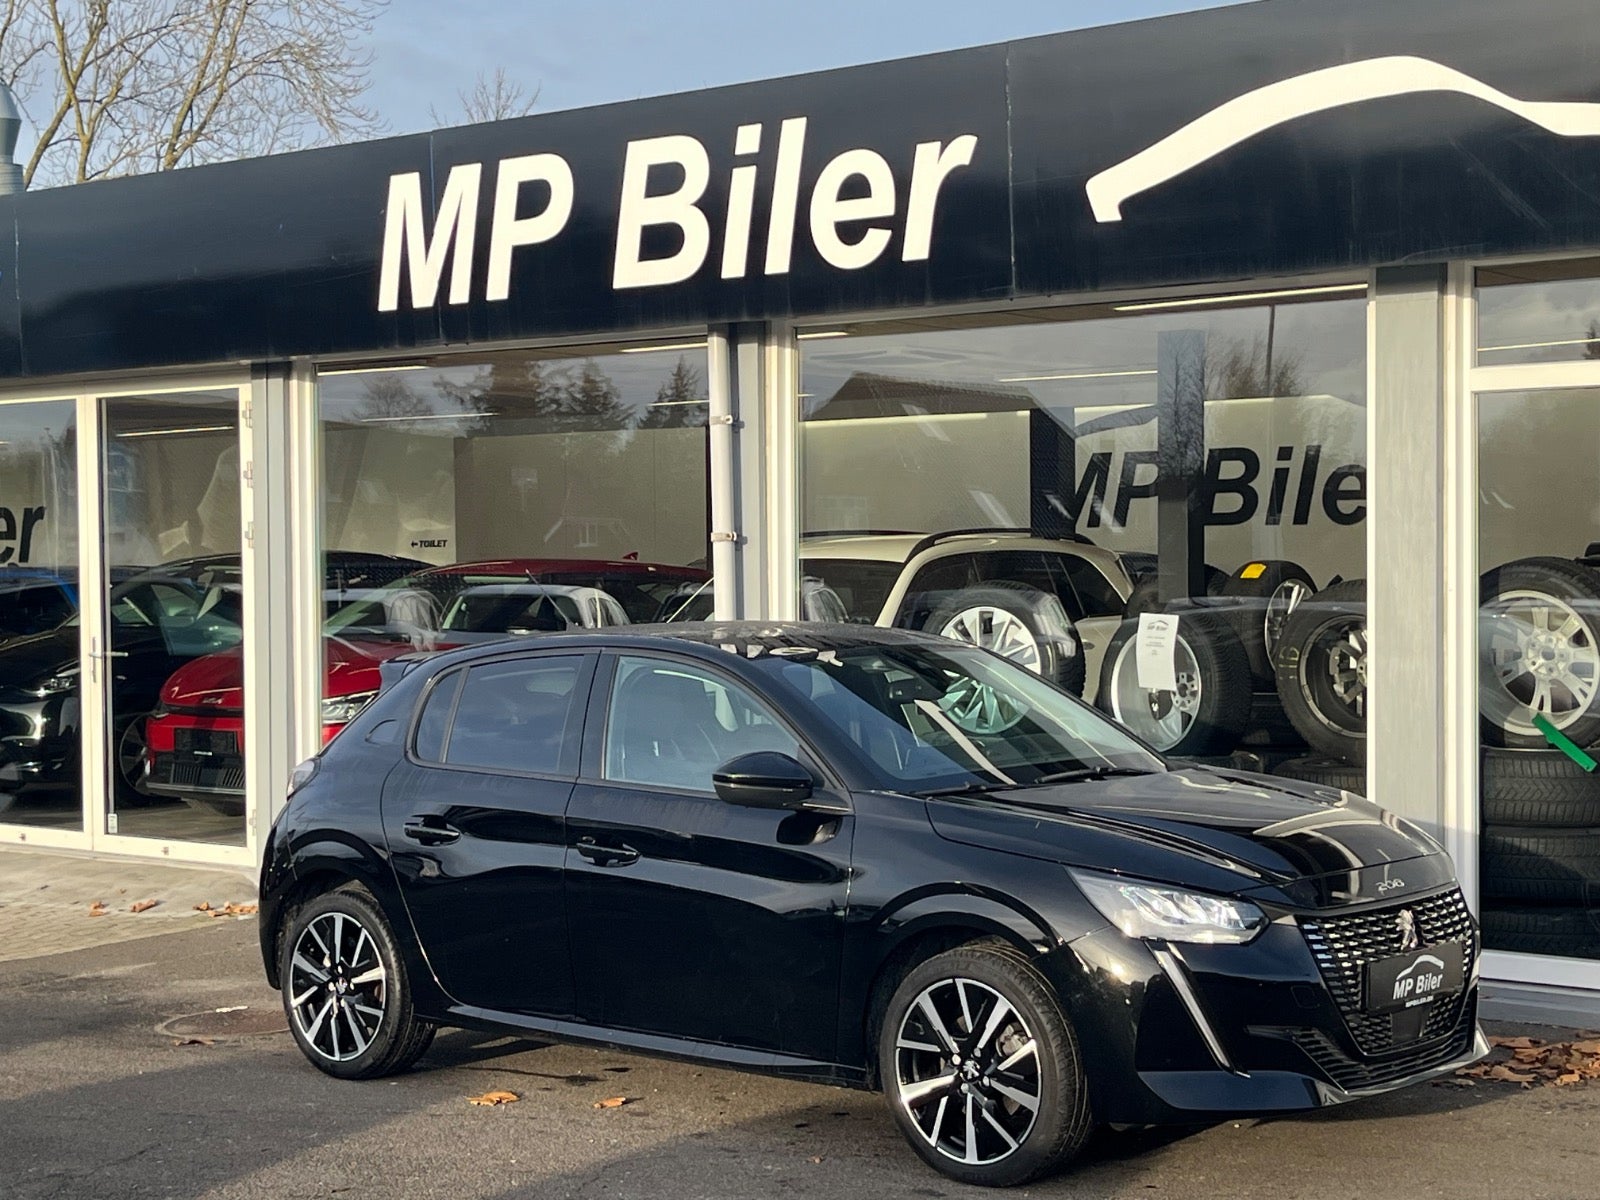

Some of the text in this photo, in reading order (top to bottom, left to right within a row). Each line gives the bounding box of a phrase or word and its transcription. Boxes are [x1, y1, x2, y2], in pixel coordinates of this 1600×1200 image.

[378, 116, 978, 312] MP Biler
[419, 540, 448, 548] TOILET
[1375, 878, 1405, 892] 208
[1393, 972, 1443, 1000] MP Biler
